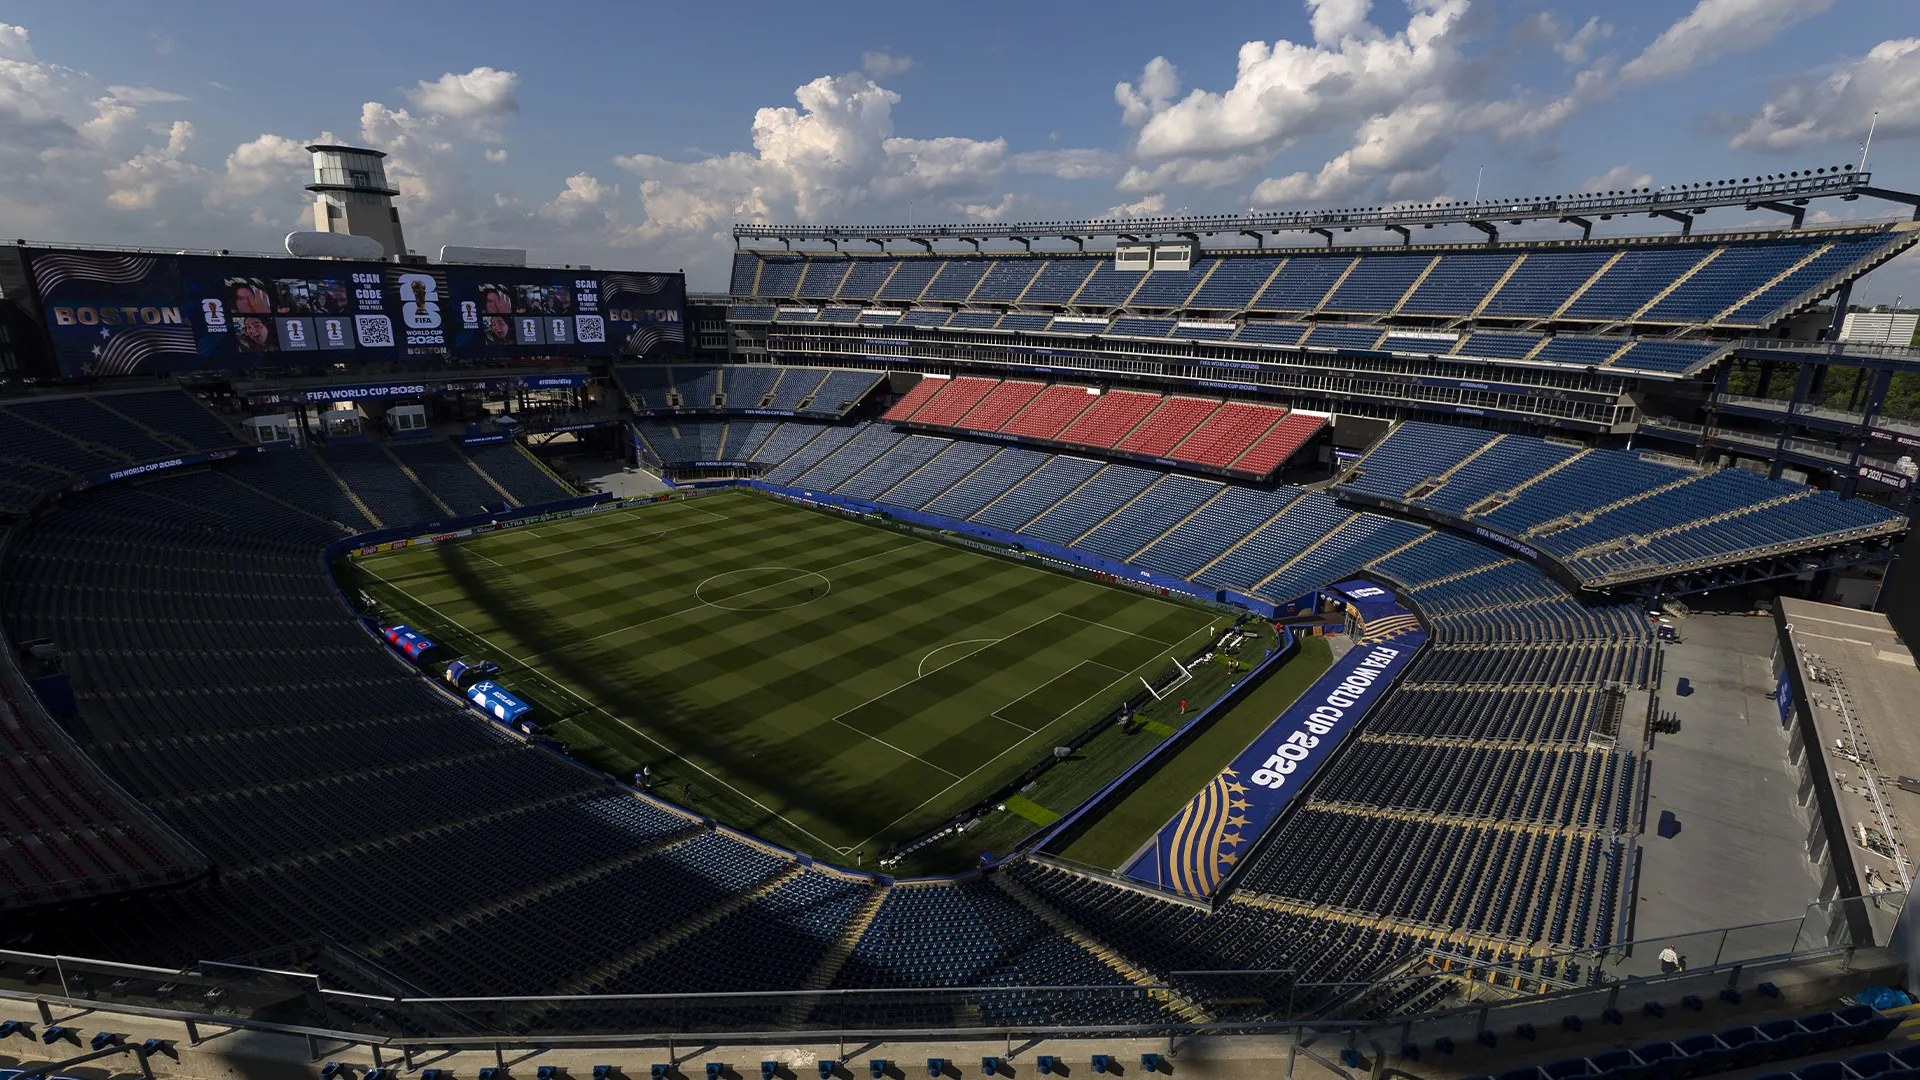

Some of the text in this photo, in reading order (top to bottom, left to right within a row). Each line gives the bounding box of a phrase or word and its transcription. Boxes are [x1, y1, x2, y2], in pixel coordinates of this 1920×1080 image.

[352, 273, 380, 283] SCAN
[576, 280, 598, 288] SCAN
[356, 290, 382, 299] CODE
[578, 294, 598, 302] CODE
[54, 306, 182, 326] BOSTON
[609, 309, 678, 322] BOSTON
[407, 336, 444, 344] 2026
[306, 385, 425, 401] FIFA WORLD CUP 2026
[110, 458, 183, 480] FIFA WORLD CUP 2026
[1867, 469, 1882, 481] 2021
[1882, 476, 1899, 486] WINNERS
[622, 500, 652, 508] Hisense
[501, 520, 524, 529] ULTRA
[1476, 527, 1538, 559] FIFA WORLD CUP 2026
[991, 547, 1017, 557] AMERICA
[1042, 560, 1075, 573] Hisense
[1115, 578, 1161, 594] McDonald's
[1360, 646, 1399, 669] FIFA
[1327, 667, 1381, 708] WORLD
[1303, 706, 1344, 735] CUP
[1251, 730, 1320, 789] 2026
